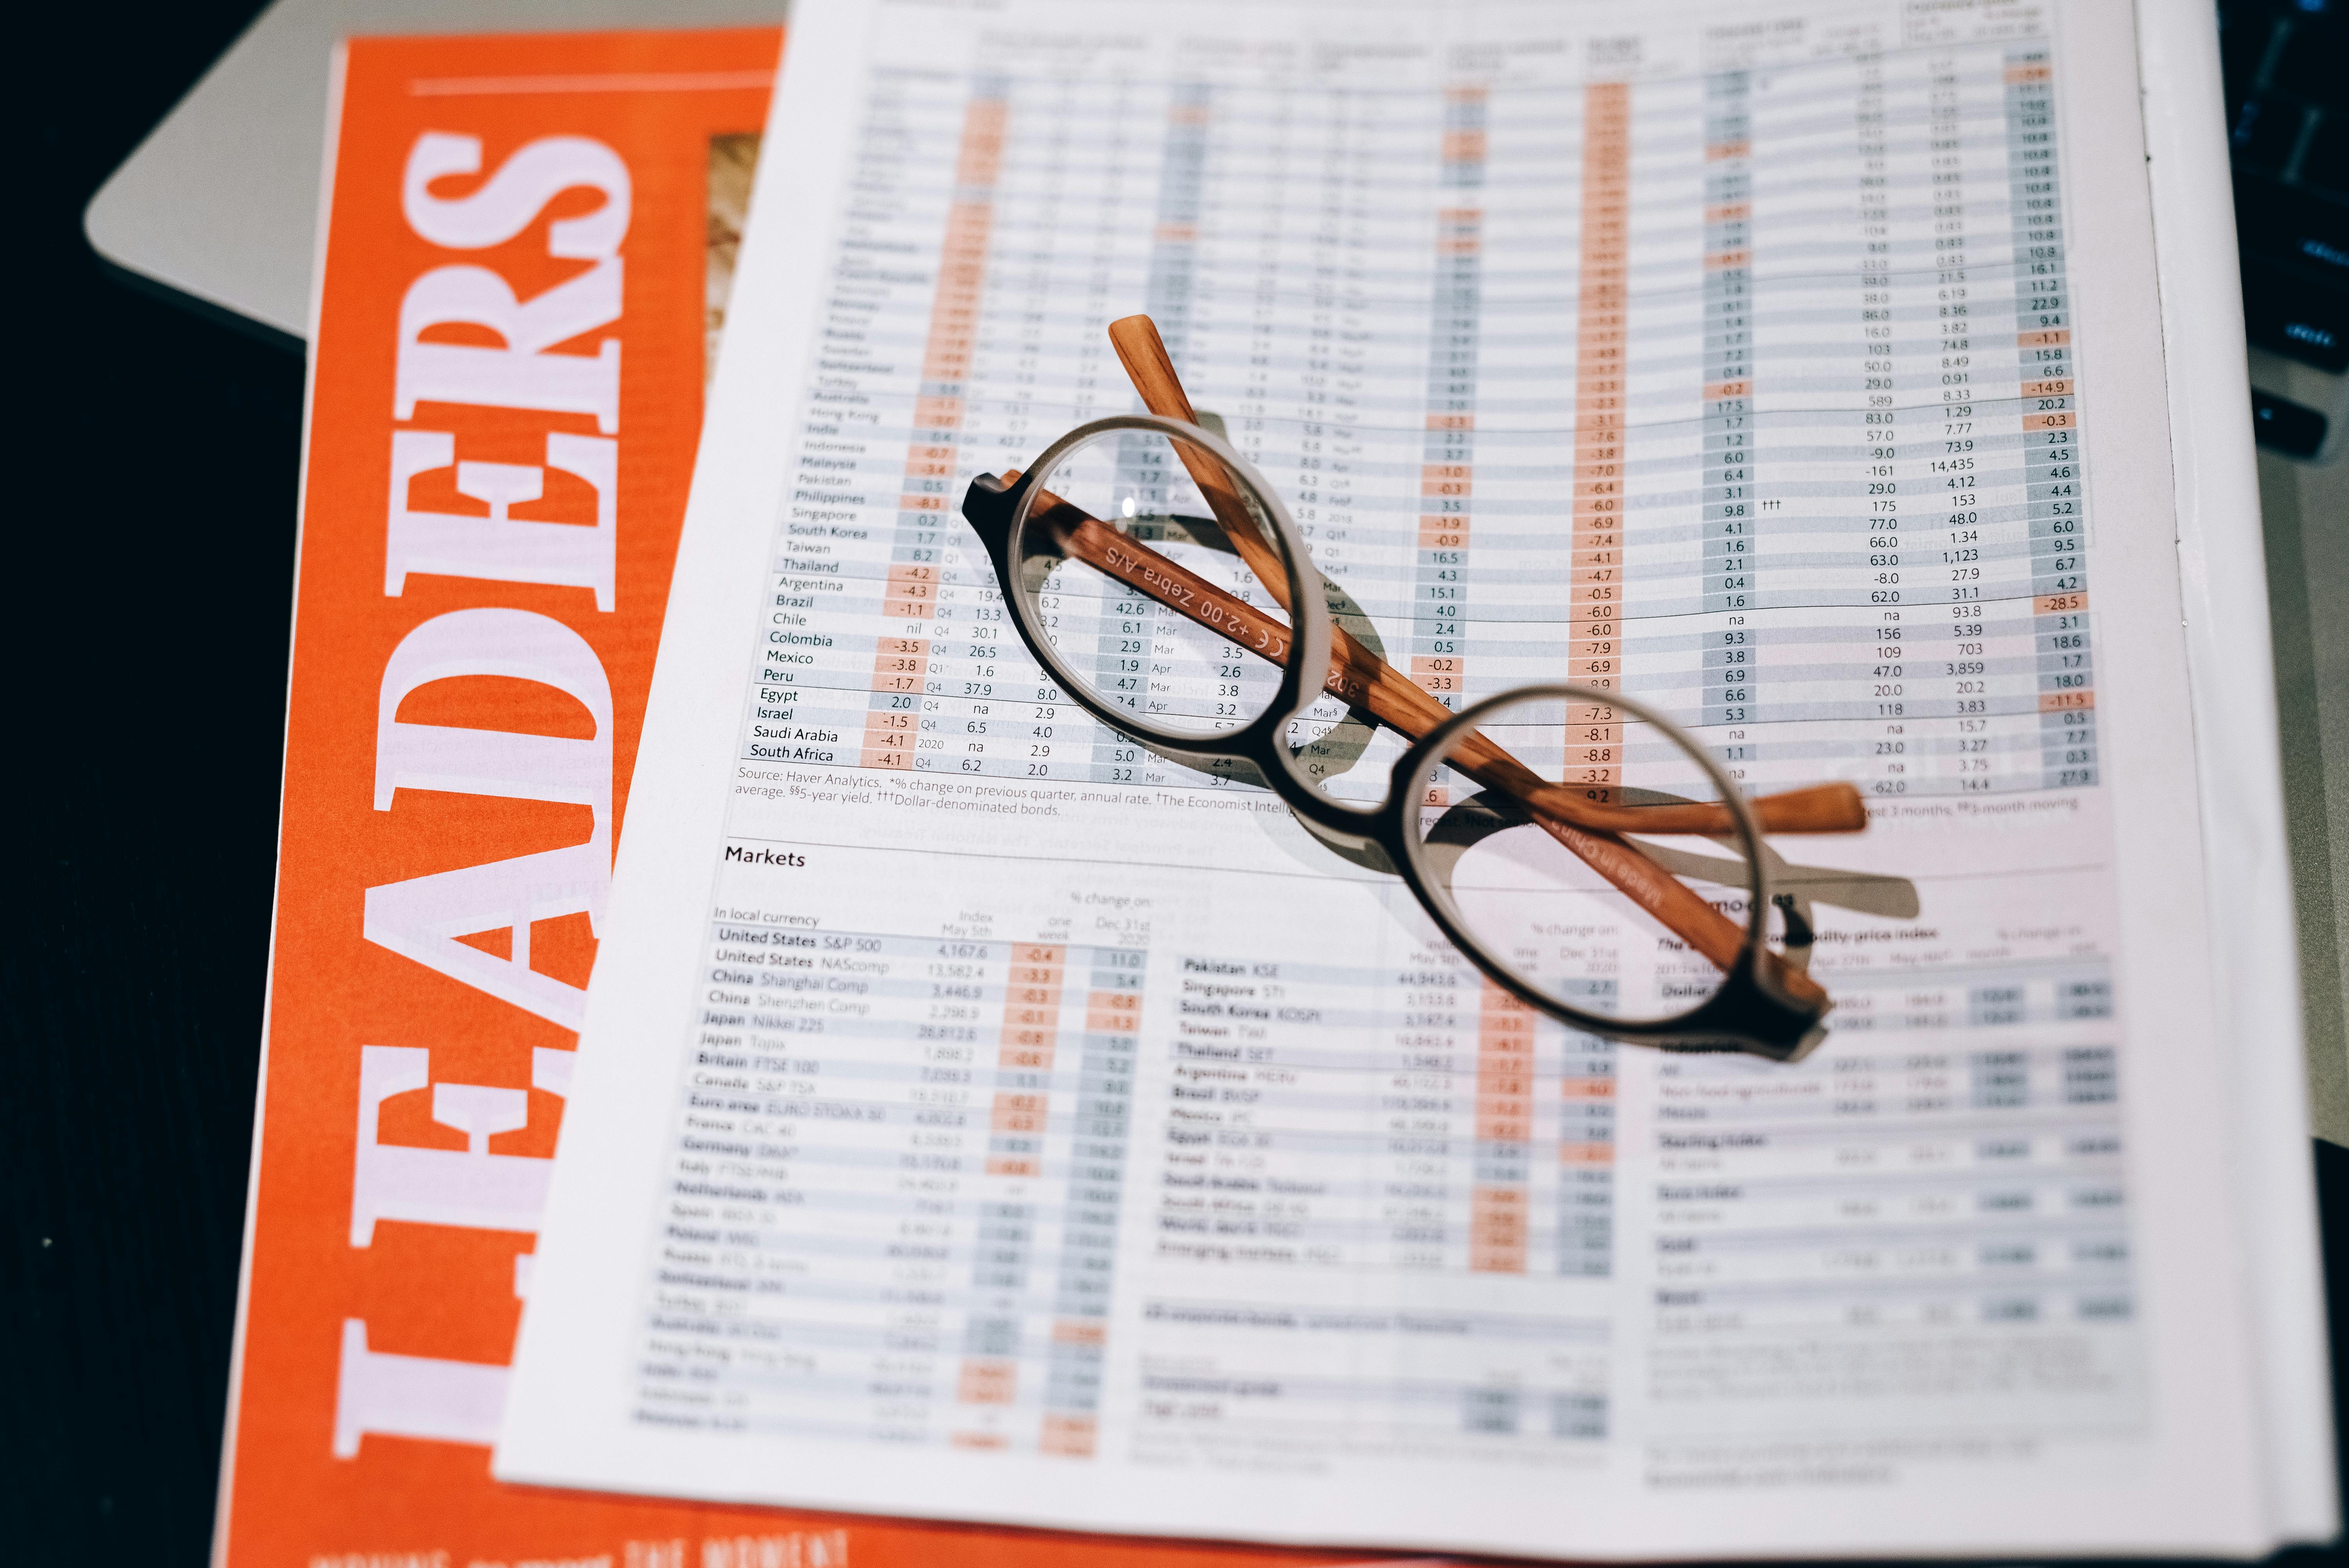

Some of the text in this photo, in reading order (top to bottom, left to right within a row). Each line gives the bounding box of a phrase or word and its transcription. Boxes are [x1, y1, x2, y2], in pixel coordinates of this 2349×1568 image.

[793, 507, 857, 521] Singapore
[795, 490, 865, 504] Philippines
[789, 523, 868, 539] South Korea
[787, 540, 2076, 600] Taiwan 15.1 -0.5 0.4 -8.0 27.9 6.7
[1104, 546, 1139, 573] A/S
[779, 577, 2079, 636] Argentina -4.3 6.2 42.6 2.4 -6.0 na na 93.8 -28.5
[783, 558, 2077, 618] Thailand -4.2 4.0 -6.0 1.6 62.0 31.1 4.2
[1142, 566, 1195, 607] Zebra
[776, 594, 1983, 654] Brazil -1.1 13.3 6.1 Mar 0.5 -7.9 9.3 156 5.39
[1200, 600, 1249, 637] +2.00
[770, 631, 1984, 690] Colombia -3.5 26.5 1.9 Apr 2.6 -3.3 6.9 47.0 3,859
[773, 612, 2082, 673] Chile nil 30.1 2.9 Mar 3.5 -0.2 -6.9 3.8 109 703 18.6
[764, 668, 794, 682] Peru
[888, 677, 914, 691] -1.7
[926, 682, 942, 693] Q4
[963, 682, 992, 697] 37.9
[1037, 688, 1057, 701] 8.0
[1148, 700, 1168, 712] Apr
[1216, 703, 1236, 716] 3.2
[1585, 707, 1612, 720] -7.3
[1725, 707, 1745, 721] 5.3
[767, 650, 1746, 702] Mexico -3.8 Q1 1.6 4.7 Mar 3.8 6.6
[757, 706, 1611, 762] Israel -1.5 Q4 6.5 4.0 Mar -8.8
[760, 688, 798, 704] Egypt
[891, 696, 911, 709] 2.0
[923, 700, 939, 711] Q4
[973, 705, 989, 715] na
[1035, 707, 1055, 720] 2.9
[1584, 728, 1609, 741] -8.1
[750, 745, 1167, 785] South Africa -4.1 Q4 6.2 2.0 3.2 Mar
[754, 725, 1609, 782] Saudi Arabia -4.1 2020 na 2.9 5.0 Mar -3.2
[332, 130, 632, 1460] LEADERS
[736, 785, 786, 799] average.
[841, 792, 872, 805] yield.
[1021, 804, 1060, 816] bonds.
[738, 767, 783, 782] Source:
[786, 772, 822, 784] Haver
[825, 774, 882, 789] Analytics.
[910, 779, 954, 796] change
[957, 784, 972, 794] on
[975, 786, 1027, 799] previous
[1031, 789, 1076, 802] quarter,
[1081, 792, 1121, 803] annual
[1126, 795, 1151, 805] rate.
[1188, 796, 1252, 811] Economist
[725, 846, 806, 867] Markets
[715, 907, 820, 929] In local currency
[720, 928, 769, 943] United
[772, 932, 817, 948] States
[823, 936, 853, 950] S&P
[856, 938, 882, 952] 500
[712, 969, 869, 994] China Shanghai Comp
